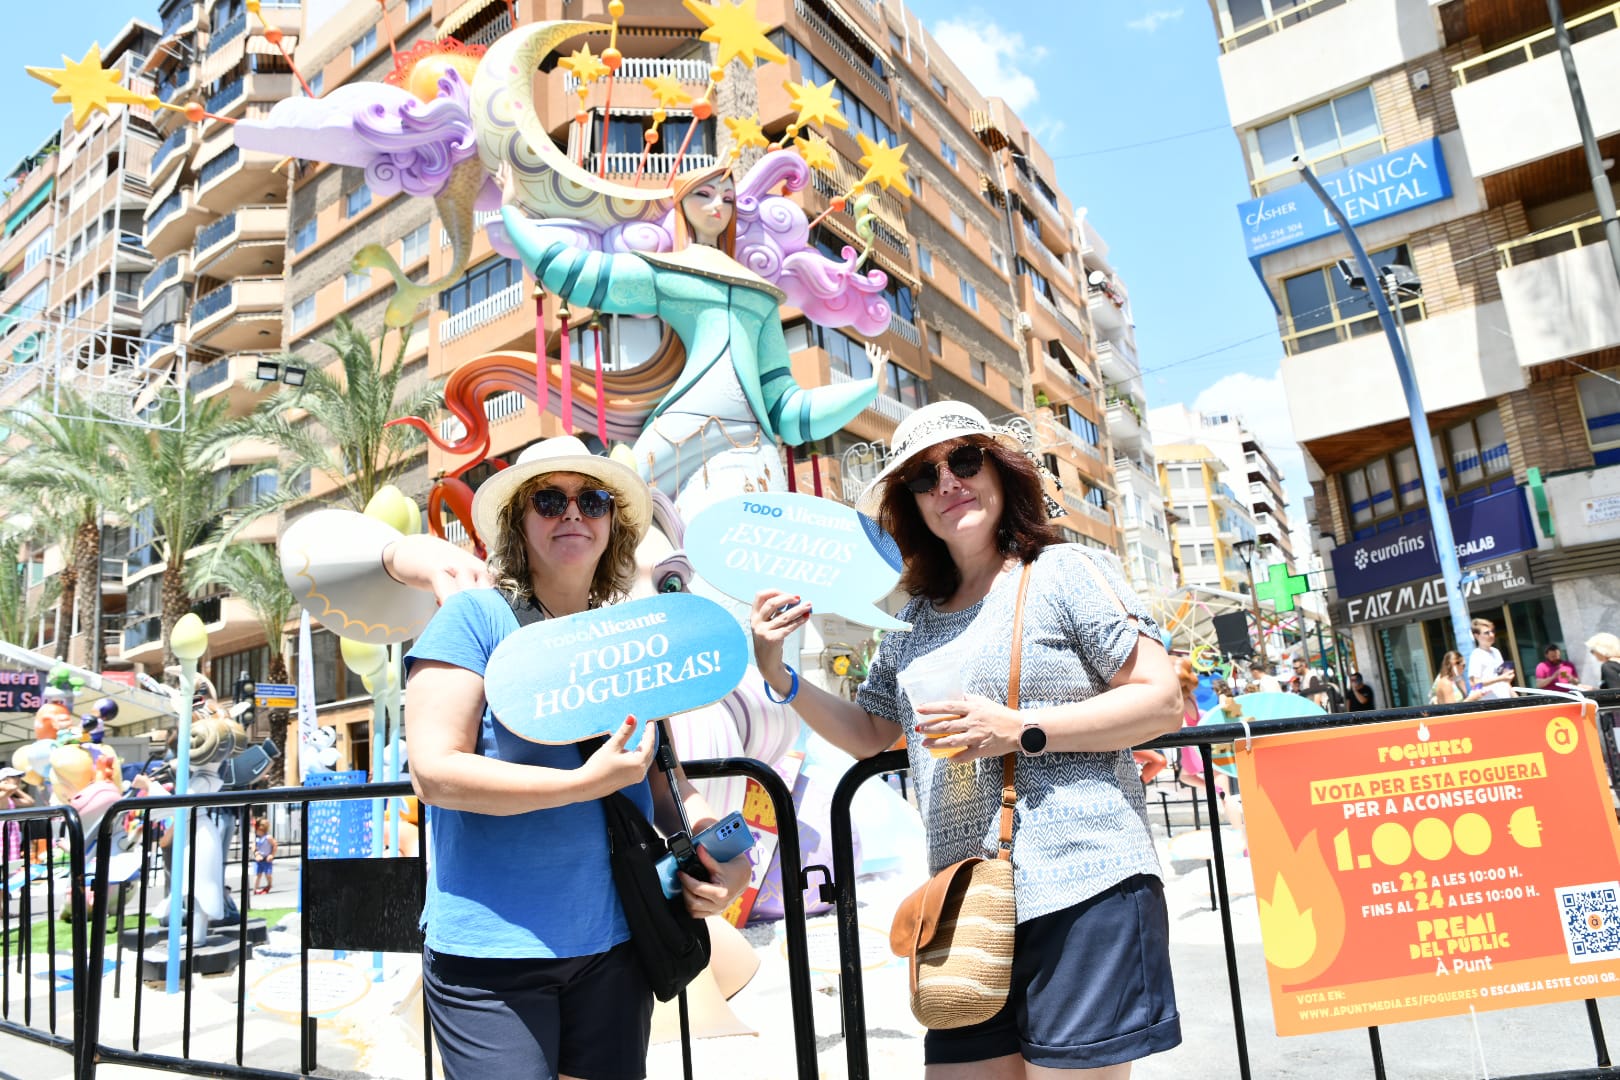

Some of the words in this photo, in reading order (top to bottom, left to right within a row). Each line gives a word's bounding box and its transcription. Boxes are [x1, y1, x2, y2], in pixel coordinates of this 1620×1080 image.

[742, 501, 783, 518] TODO
[784, 505, 858, 532] Alicante
[719, 522, 858, 563] ¡ESTAMOS
[1370, 535, 1425, 564] eurofins
[1454, 535, 1496, 558] EGALAB
[725, 547, 773, 573] ON
[764, 556, 841, 587] FIRE!
[1347, 570, 1482, 623] FARMACA
[569, 633, 669, 684] ¡TODO
[533, 650, 721, 720] HOGUERAS!
[1378, 737, 1473, 763] FOGUERES
[1314, 781, 1365, 802] VOTA
[1369, 777, 1406, 796] PER
[1410, 771, 1455, 791] ESTA
[1459, 762, 1542, 784] FOGUERA
[1342, 800, 1380, 819] PER
[1385, 798, 1399, 815] A
[1402, 784, 1524, 813] ACONSEGUIR:
[1333, 812, 1492, 872] 1.000
[1507, 805, 1543, 849] €
[1372, 880, 1399, 895] DEL
[1399, 870, 1429, 892] 22
[1431, 875, 1441, 888] A
[1443, 871, 1467, 887] LES
[1469, 868, 1507, 883] 10:00
[1508, 865, 1524, 879] H.
[1361, 902, 1394, 918] FINS
[1397, 900, 1414, 914] AL
[1414, 889, 1445, 912] 24
[1448, 895, 1458, 908] A
[1460, 890, 1484, 907] LES
[1486, 887, 1524, 902] 10:00
[1525, 884, 1540, 898] H.
[1416, 911, 1497, 943] PREMI
[1409, 941, 1445, 960] DEL
[1435, 956, 1450, 977] À
[1453, 955, 1493, 974] Punt
[1296, 992, 1325, 1005] VOTA
[1327, 990, 1346, 1001] EN:
[1298, 988, 1479, 1021] WWW.APUNTMEDIA.ES/FOGUERES
[1480, 987, 1489, 998] O
[1490, 981, 1545, 997] ESCANEJA
[1545, 977, 1573, 990] ESTE
[1573, 974, 1599, 987] CODI
